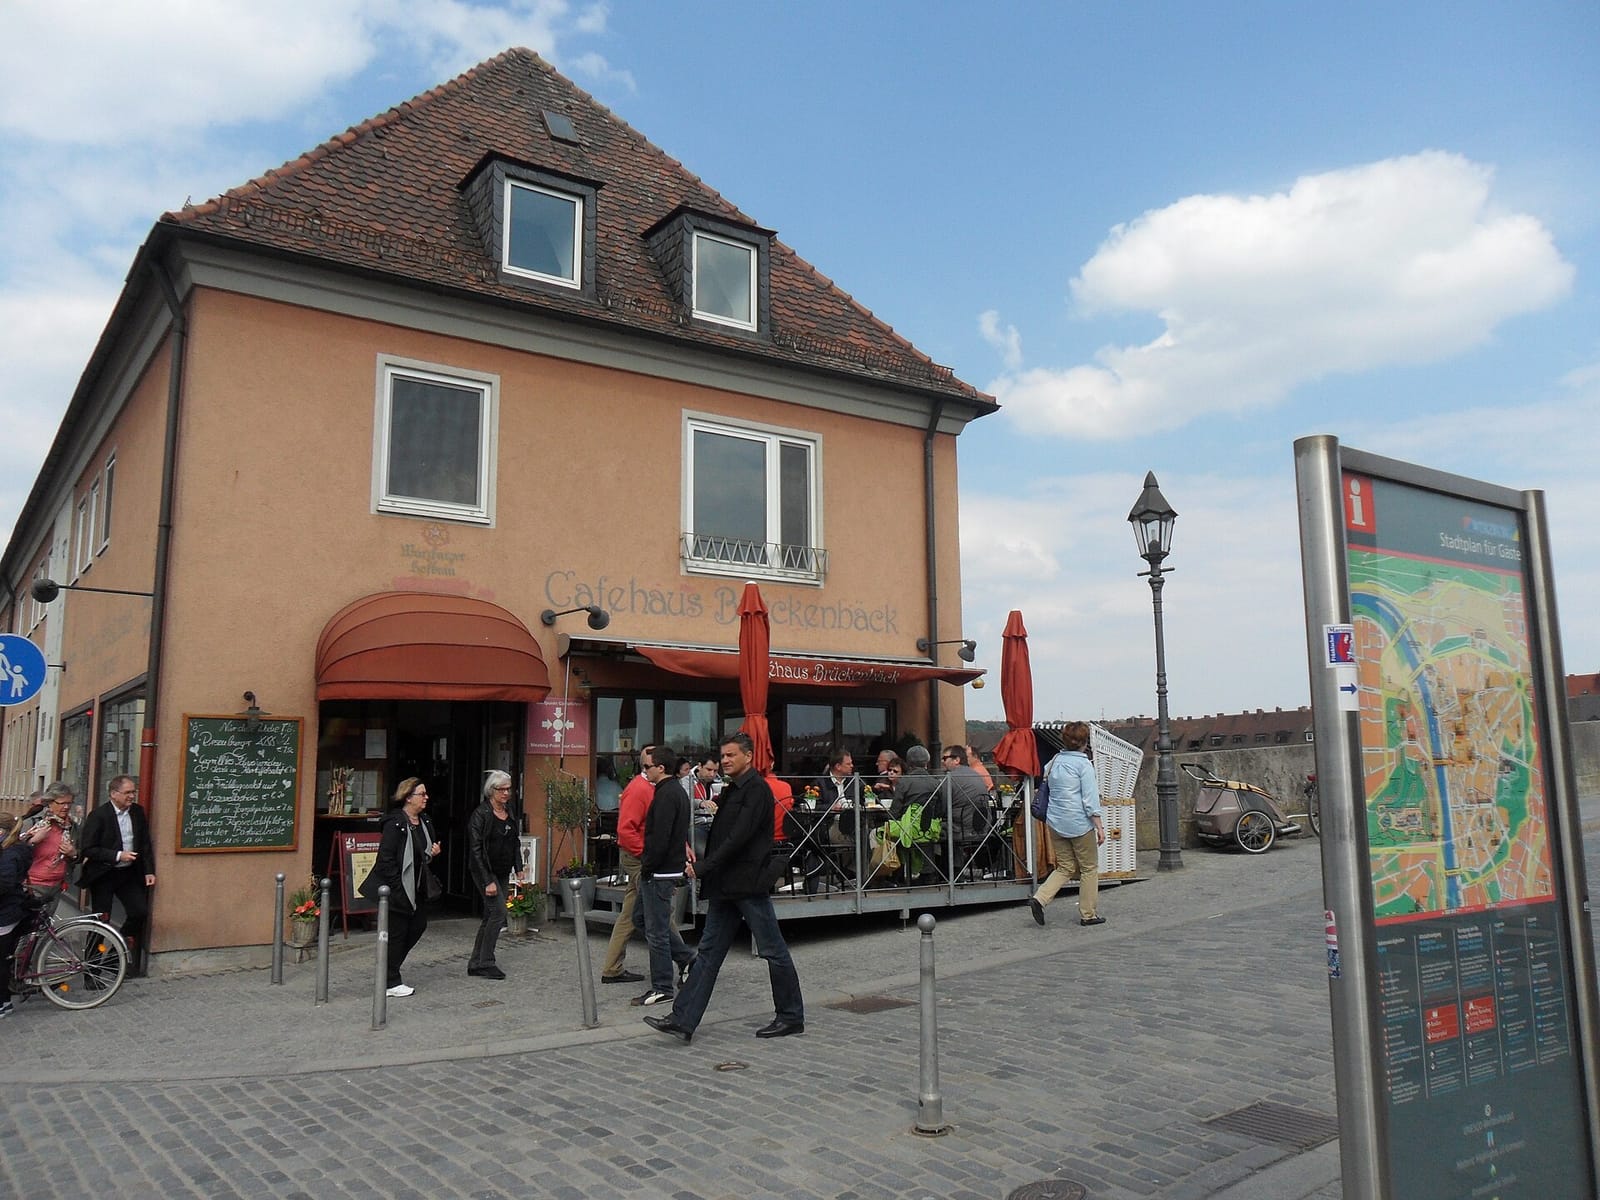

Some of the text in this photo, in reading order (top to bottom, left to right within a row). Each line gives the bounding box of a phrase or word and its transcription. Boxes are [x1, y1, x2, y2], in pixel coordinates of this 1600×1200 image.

[1439, 531, 1482, 553] Stadtplan
[1498, 543, 1522, 561] Gäste
[714, 586, 898, 634] Bckenbäck
[769, 660, 900, 683] éhaus Brückenbäck
